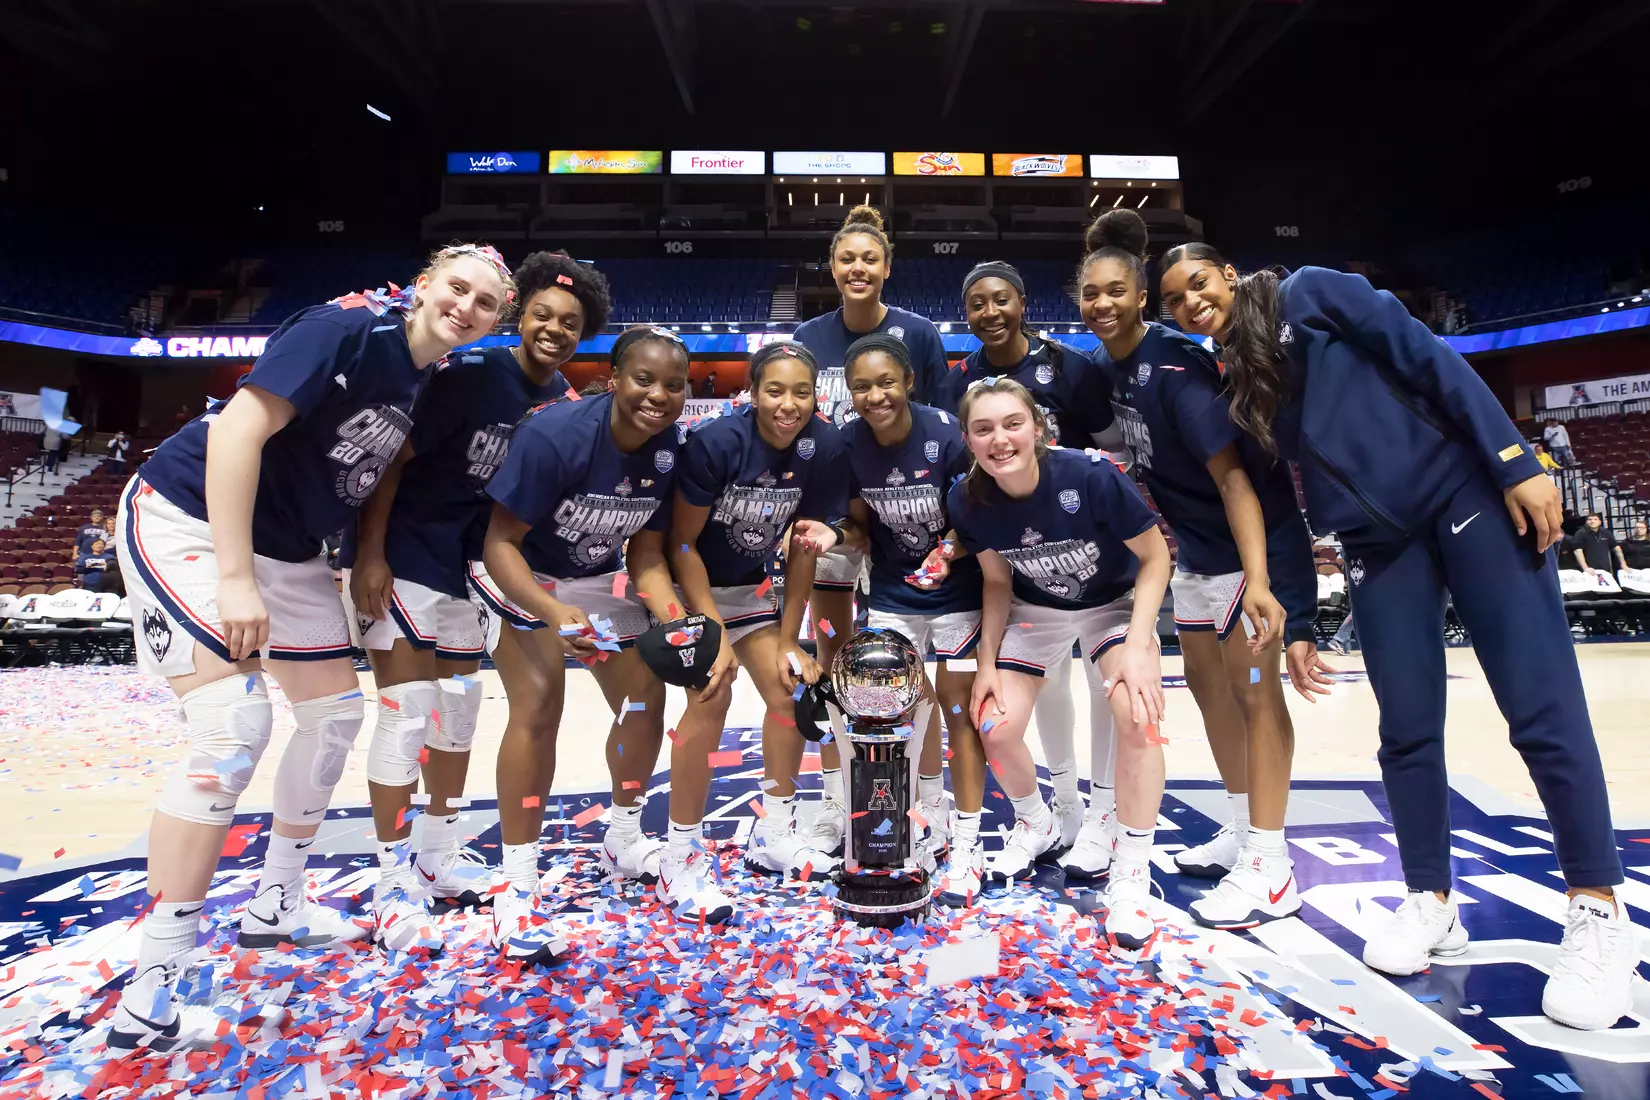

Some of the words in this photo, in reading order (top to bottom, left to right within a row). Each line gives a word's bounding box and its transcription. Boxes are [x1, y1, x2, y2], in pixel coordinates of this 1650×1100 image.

[496, 157, 517, 166] Den
[691, 156, 744, 168] Frontier
[1556, 176, 1592, 194] 109
[317, 220, 344, 232] 105
[1275, 225, 1299, 237] 108
[664, 241, 692, 253] 106
[933, 242, 959, 254] 107
[1602, 383, 1627, 397] THE
[330, 441, 365, 464] 20
[468, 463, 494, 478] 20
[891, 488, 938, 498] BASKETBALL
[714, 508, 733, 525] 20
[556, 526, 580, 542] 20
[725, 528, 741, 554] UCONN
[1030, 541, 1083, 557] BASKETBALL
[1077, 564, 1098, 581] 20
